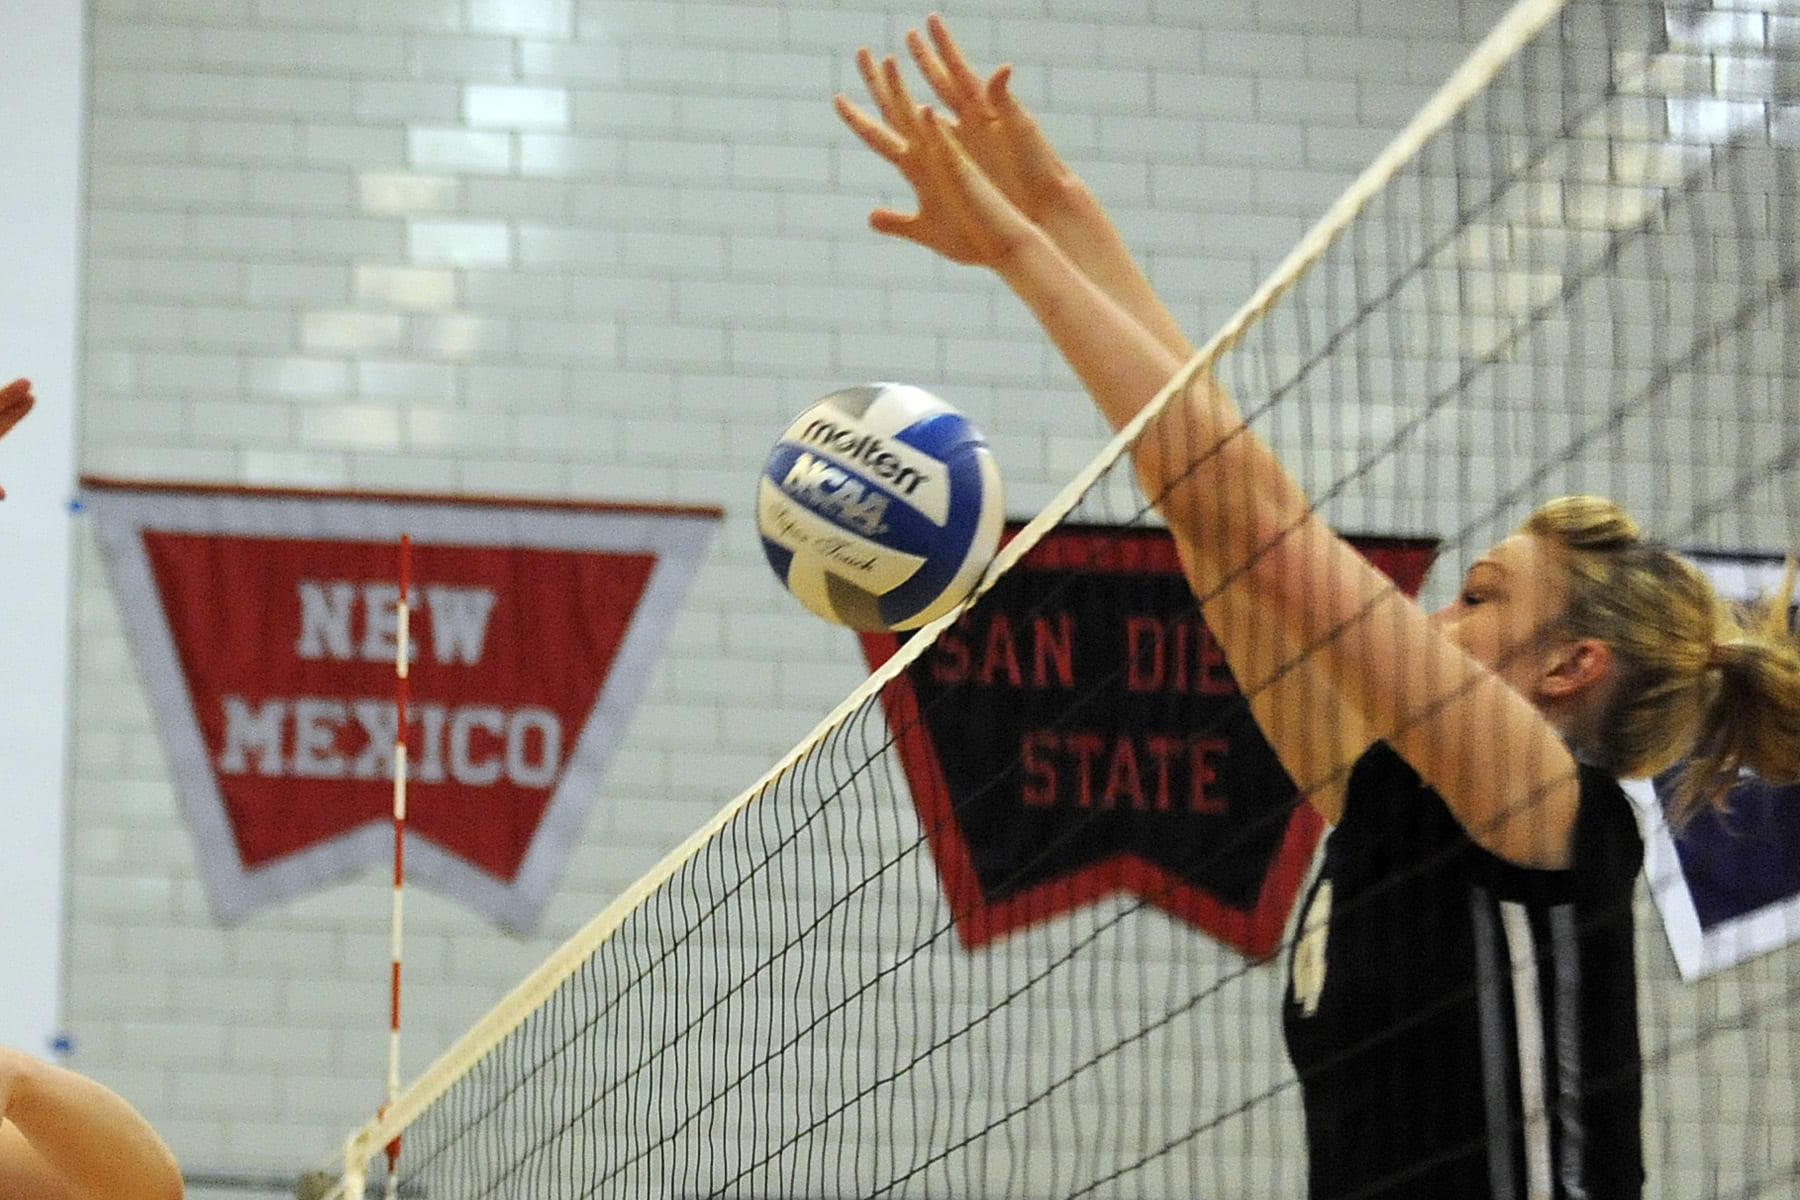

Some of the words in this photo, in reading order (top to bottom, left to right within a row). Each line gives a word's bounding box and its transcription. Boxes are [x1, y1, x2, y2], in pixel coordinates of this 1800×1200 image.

[780, 450, 890, 538] NCAA
[802, 419, 929, 495] molten
[298, 580, 496, 666] NEW
[931, 610, 1074, 688] SAN
[1126, 615, 1243, 695] DIE
[217, 696, 565, 789] MEXICO
[1021, 732, 1230, 813] STATE
